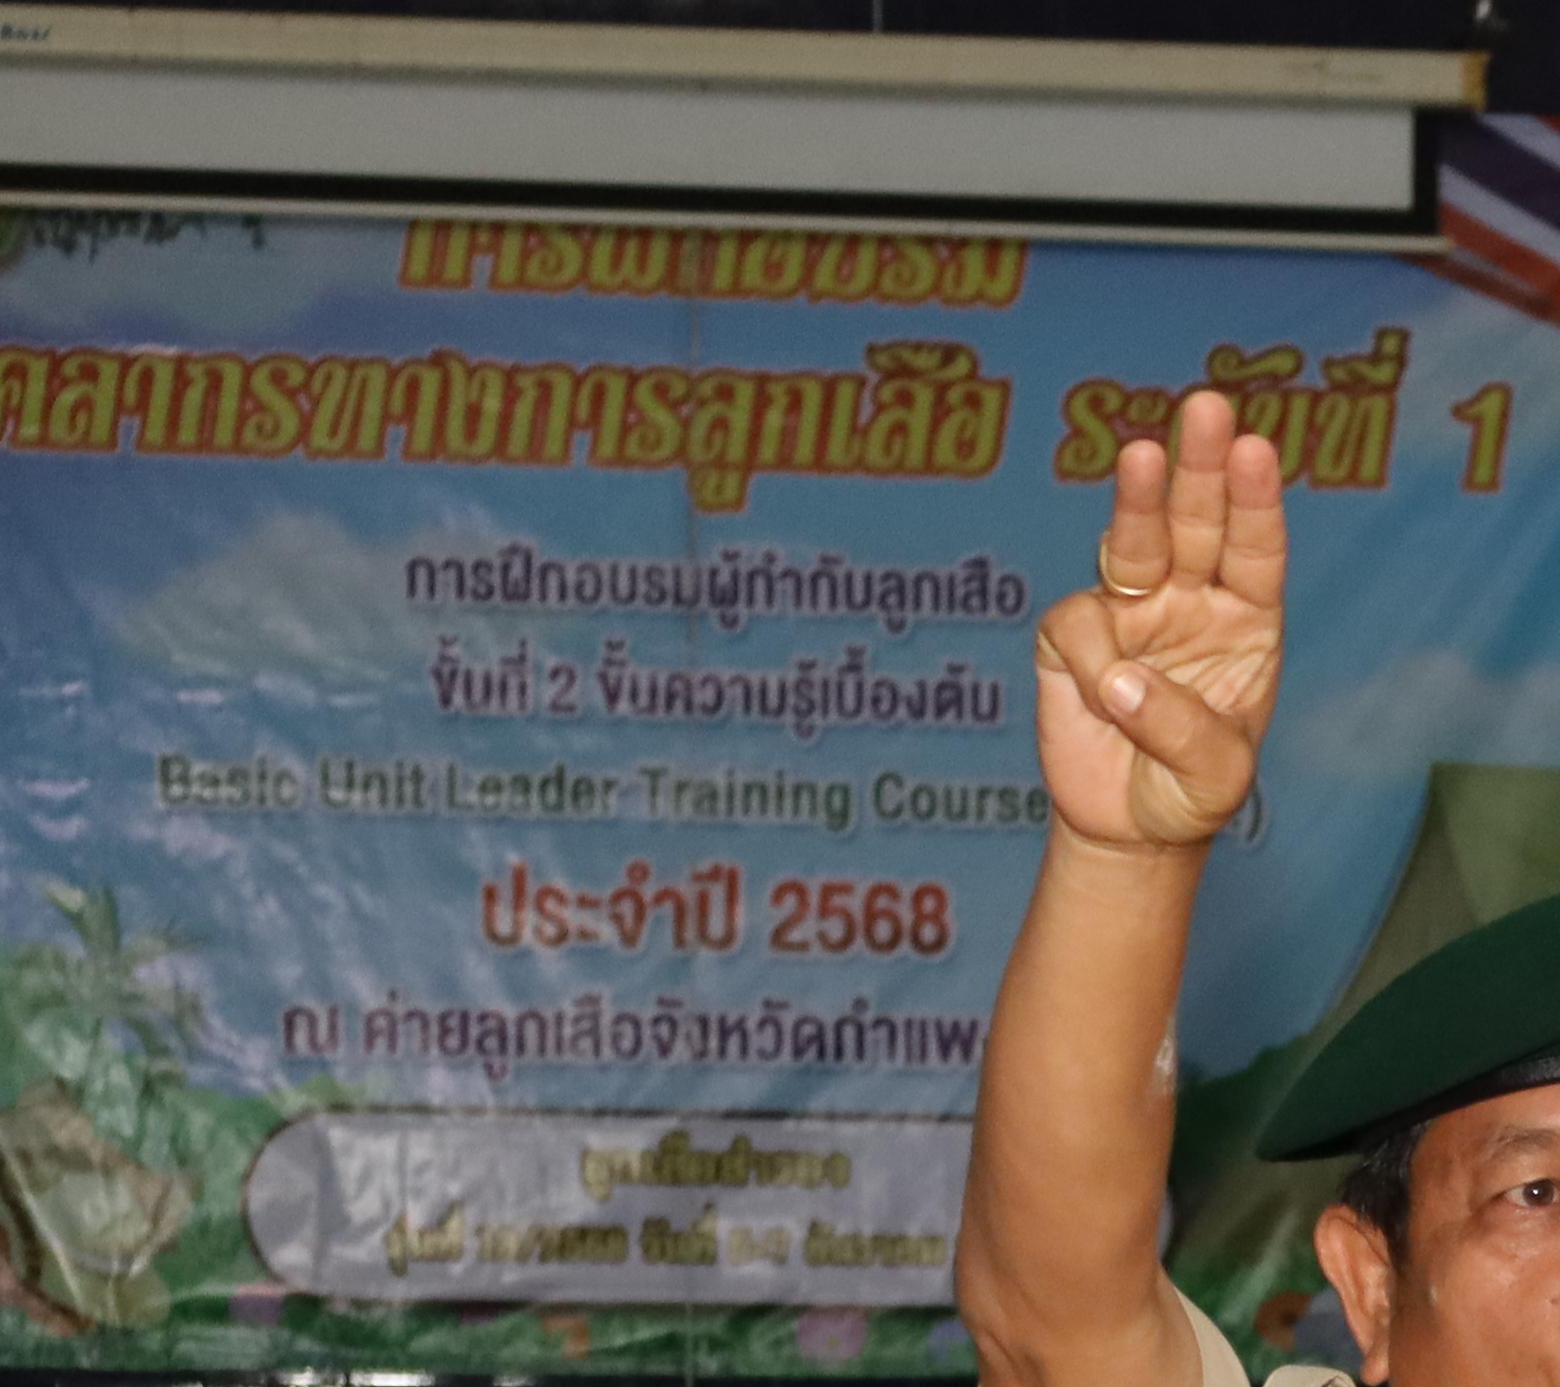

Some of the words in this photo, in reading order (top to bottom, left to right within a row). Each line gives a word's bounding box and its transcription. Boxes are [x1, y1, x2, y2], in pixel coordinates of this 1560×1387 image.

[1451, 383, 1514, 490] 1
[404, 546, 1026, 632] การฝึกอบรมผู้กำกับลูกเสือ
[547, 664, 578, 714] 2
[597, 640, 1004, 737] ขั้นความรู้เบื้องต้น
[156, 756, 300, 812] Basic
[318, 757, 426, 812] Unit
[446, 761, 620, 815] Leader
[638, 764, 854, 833] Training
[871, 772, 1049, 825] Course
[481, 857, 741, 951] ประจำปี
[769, 880, 951, 954] 2568
[282, 1001, 339, 1057] ณ
[362, 988, 989, 1077] ค่ายลูกเสือจังหวัดกำแพ
